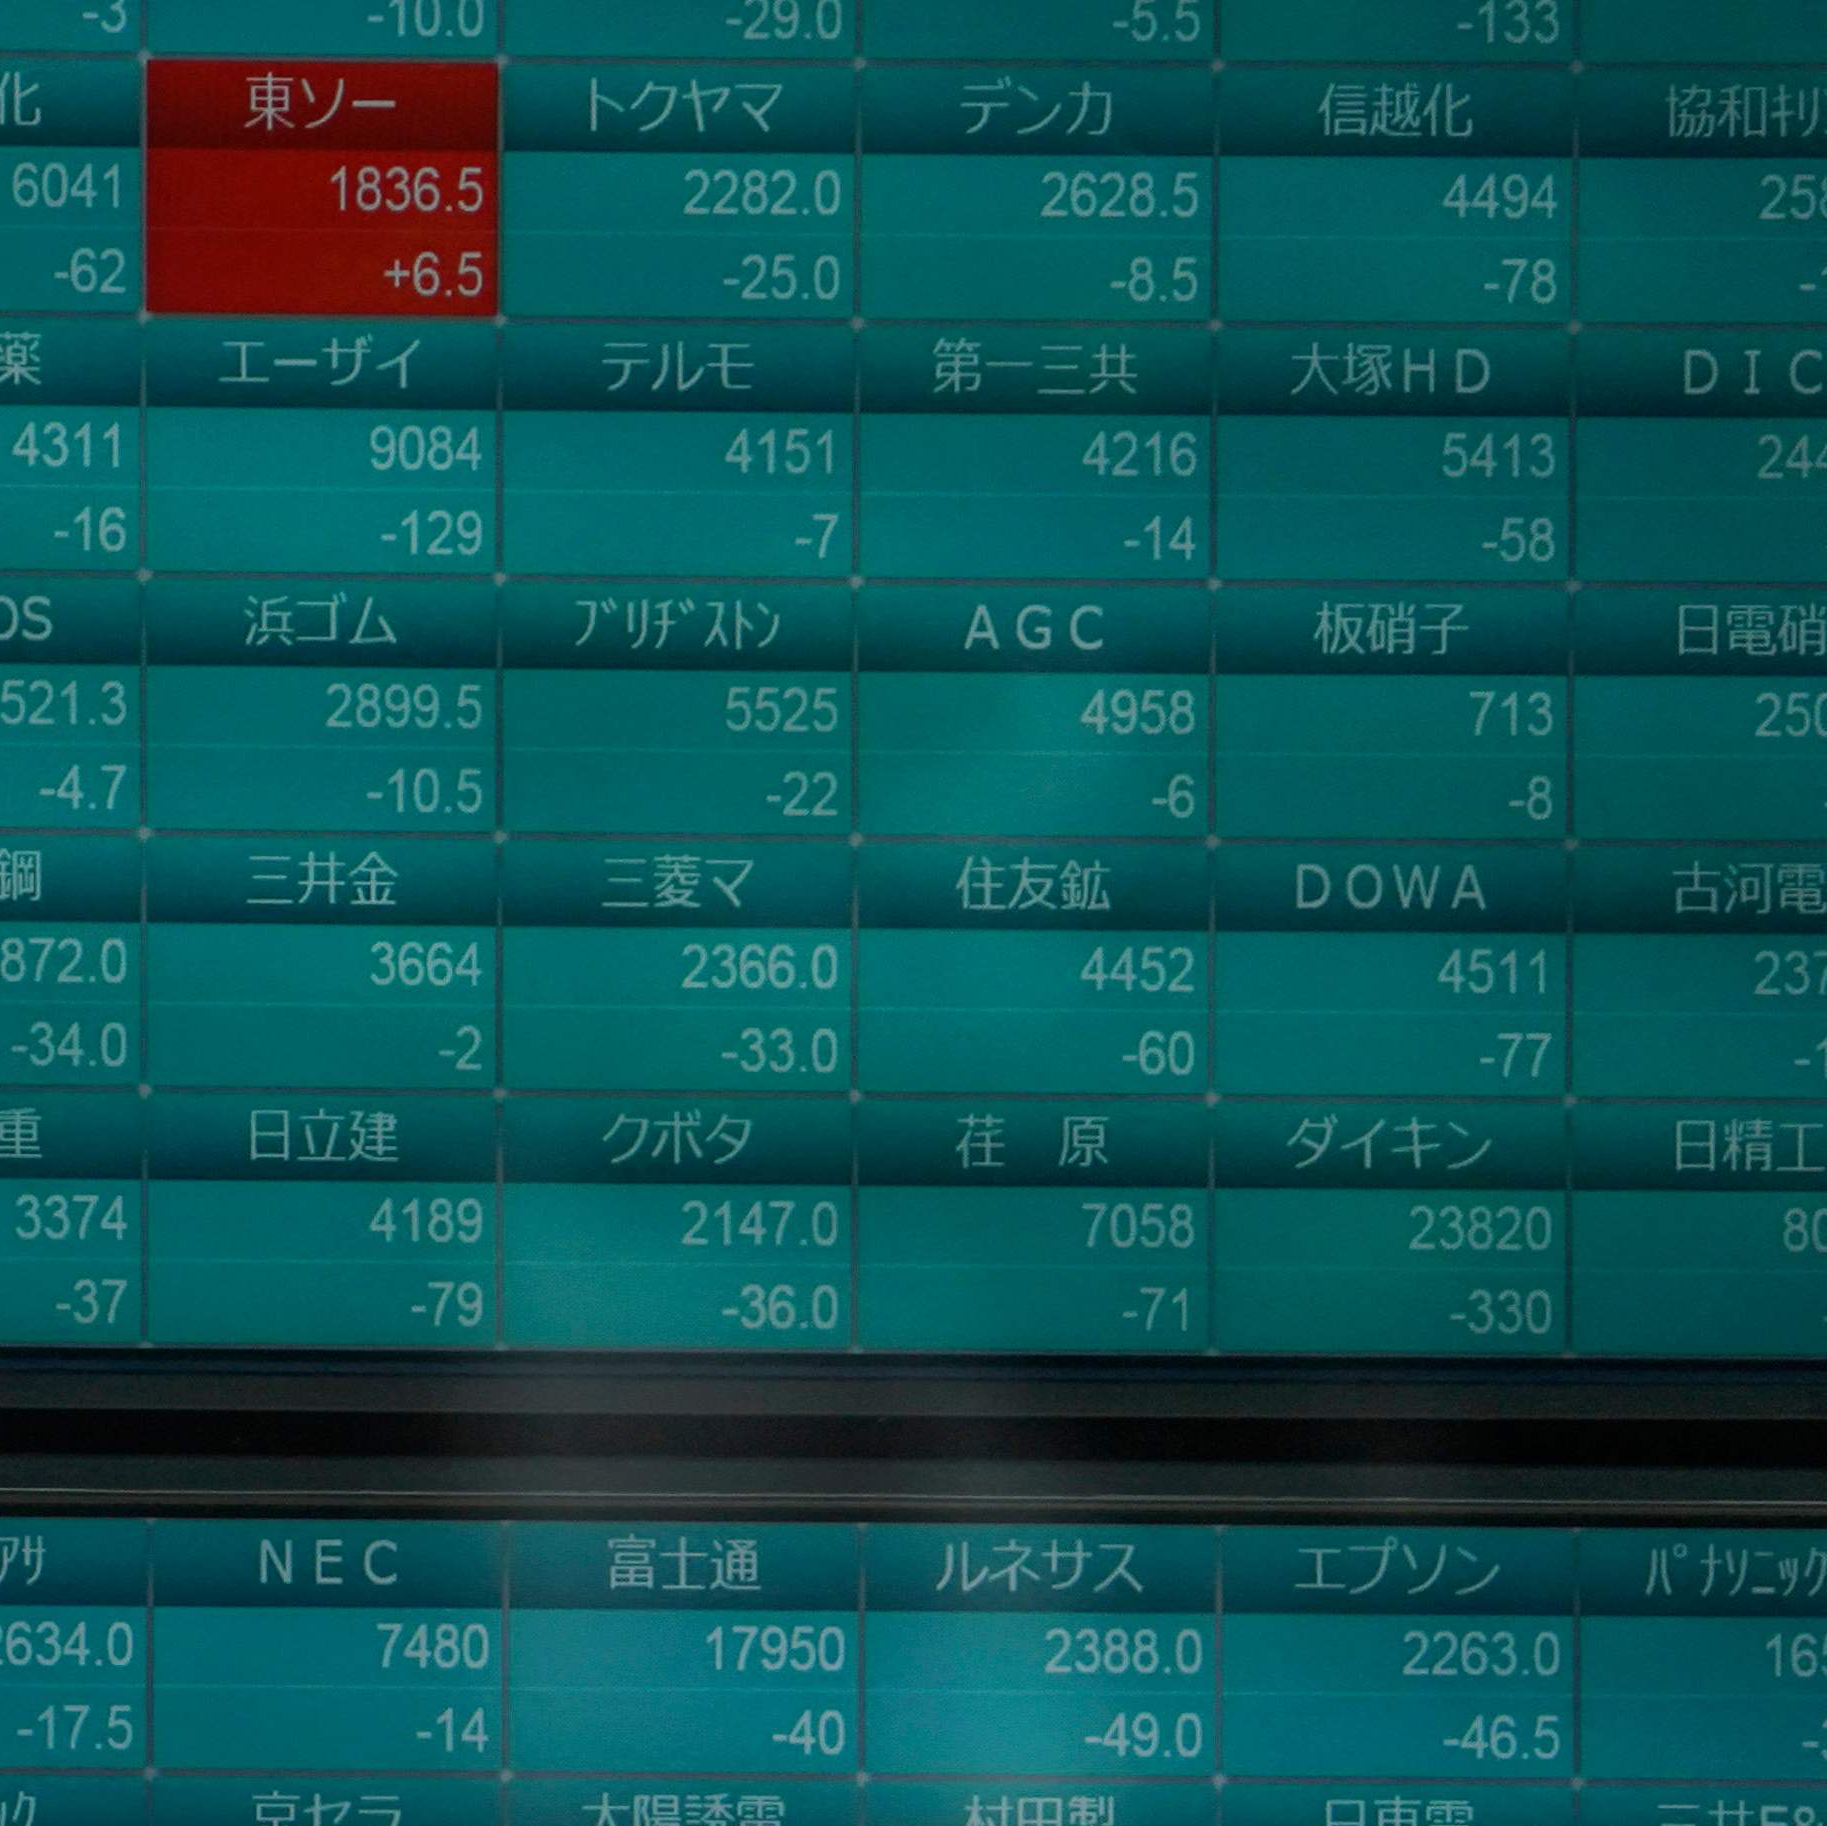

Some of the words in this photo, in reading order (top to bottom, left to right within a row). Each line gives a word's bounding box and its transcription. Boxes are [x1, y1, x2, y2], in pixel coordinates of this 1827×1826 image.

[244, 71, 397, 131] 東ソー
[590, 78, 782, 132] トクヤマ
[961, 77, 1112, 135] デンカ
[1318, 84, 1473, 137] 信越化
[12, 162, 119, 208] 6041
[330, 165, 484, 214] 1836.5
[1040, 171, 1198, 218] 2628.5
[1443, 174, 1557, 219] 4494
[383, 250, 484, 298] +6.5
[220, 335, 420, 389] エーザイ
[603, 341, 753, 391] テルモ
[933, 338, 1137, 395] 第一三共
[370, 425, 482, 471] 9084
[1082, 431, 1197, 477] 4216
[1443, 432, 1554, 478] 5413
[245, 592, 397, 645] 浜ゴム
[1314, 601, 1468, 655] 板硝子
[0, 679, 127, 726] 521.3
[726, 686, 838, 732] 5525
[247, 851, 398, 905] 三井金
[602, 854, 754, 908] 三菱マ
[955, 855, 1110, 911] 住友鉱
[1438, 948, 1545, 994] 4511
[250, 1108, 398, 1162] 日立建
[603, 1110, 751, 1164] クボタ
[1287, 1114, 1490, 1169] ダイキン
[1409, 1205, 1551, 1250] 23820
[1450, 1289, 1551, 1334] -330
[607, 1533, 762, 1591] 富士通
[935, 1539, 1143, 1593] ルネサス
[1295, 1536, 1499, 1595] エプソン
[705, 1624, 846, 1672] 17950
[1402, 1630, 1560, 1677] 2263.0
